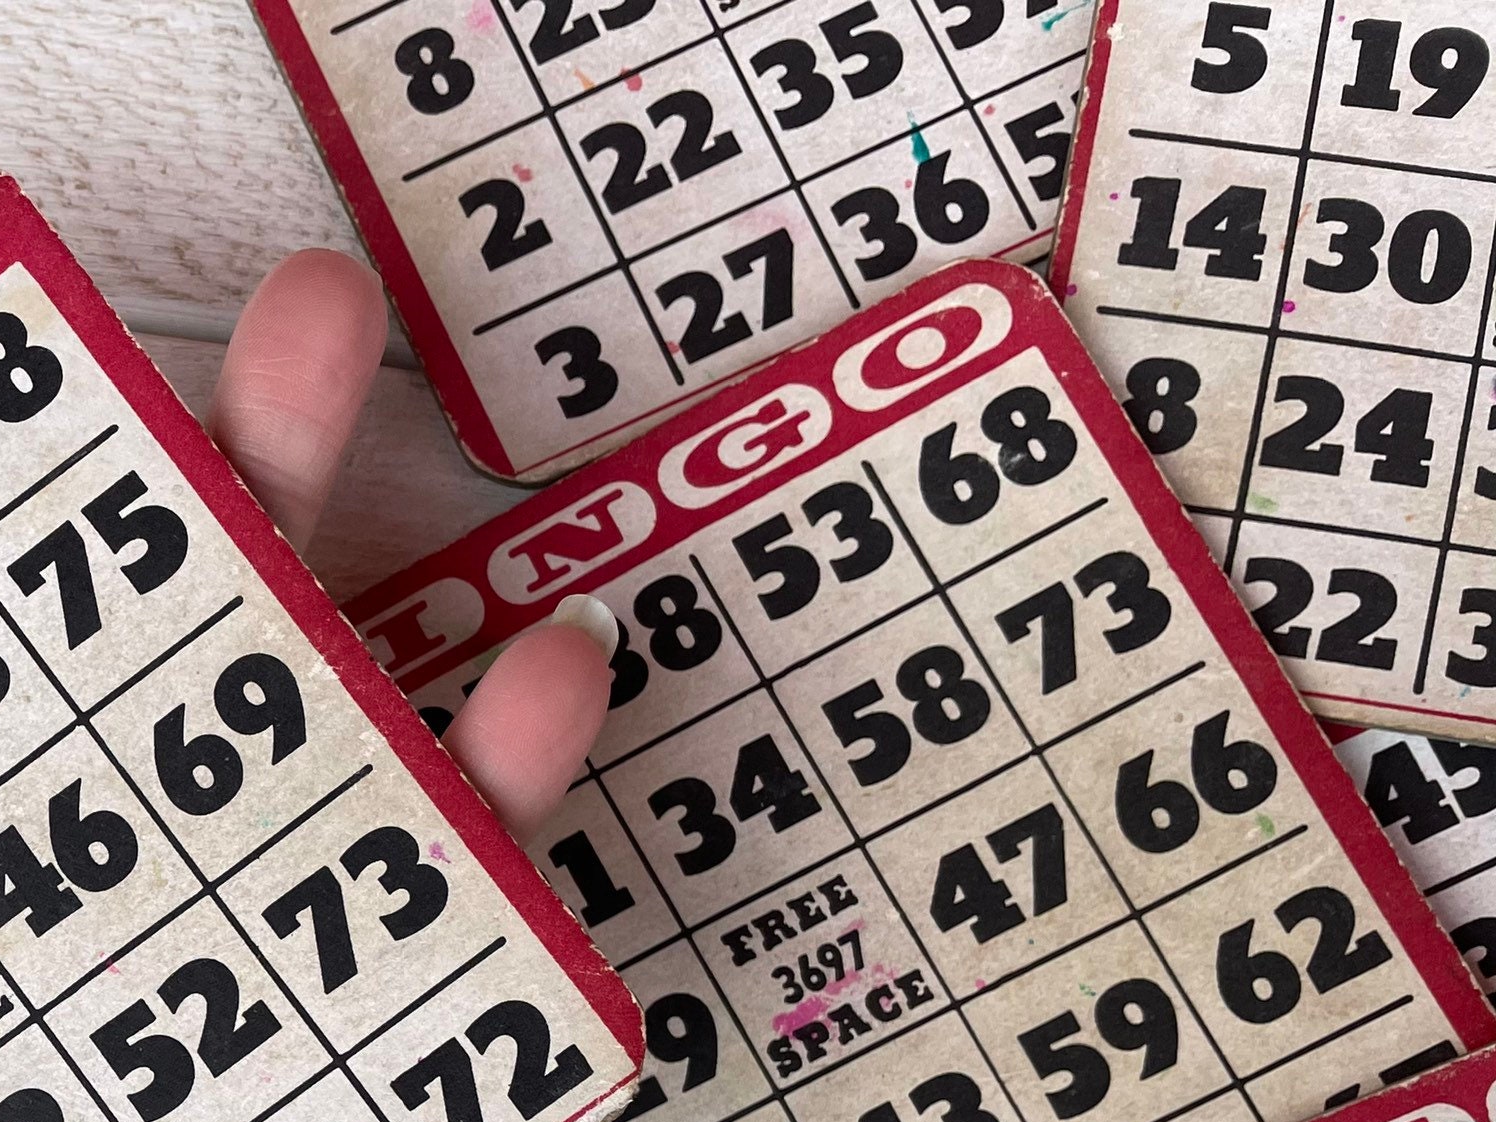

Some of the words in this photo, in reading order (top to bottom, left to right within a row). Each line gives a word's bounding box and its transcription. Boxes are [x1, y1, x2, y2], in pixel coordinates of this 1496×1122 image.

[395, 28, 474, 114] 8
[514, 0, 657, 66] 2
[750, 1, 903, 130] 35
[1191, 2, 1271, 93] 5
[1341, 19, 1489, 118] 19
[459, 179, 552, 271] 2
[580, 90, 742, 214] 22
[831, 150, 989, 281] 36
[1004, 90, 1080, 202] 5
[1118, 177, 1267, 281] 14
[1303, 198, 1472, 304] 30
[535, 326, 618, 419] 3
[656, 228, 793, 364] 27
[732, 482, 893, 620] 53
[919, 387, 1077, 524] 68
[1122, 358, 1200, 456] 8
[1259, 376, 1434, 488] 24
[7, 470, 188, 650] 75
[1244, 558, 1397, 670] 22
[154, 653, 306, 815] 69
[540, 829, 636, 930] 1
[647, 734, 822, 876] 34
[822, 646, 990, 786] 58
[995, 551, 1171, 694] 73
[930, 803, 1067, 944] 47
[1116, 710, 1277, 853] 66
[90, 958, 282, 1122] 52
[261, 827, 448, 994] 73
[720, 874, 858, 967] FREE
[771, 929, 864, 1004] 3697
[767, 969, 934, 1078] SPACE
[1018, 979, 1178, 1119] 59
[1217, 887, 1392, 1024] 62
